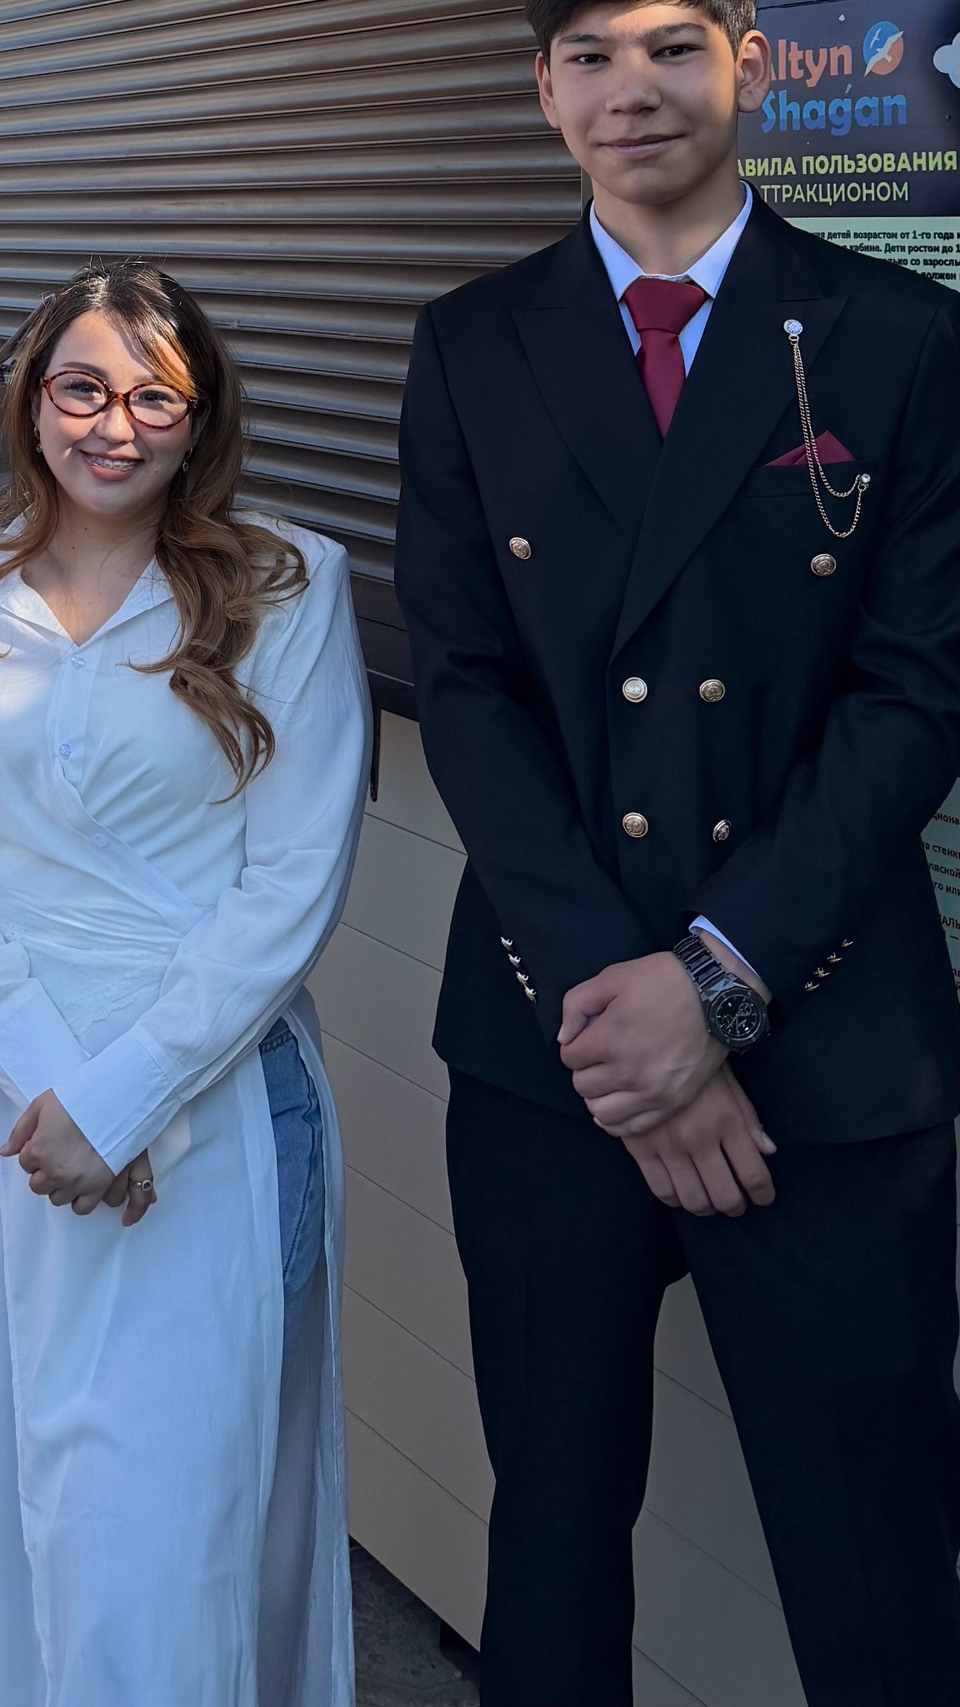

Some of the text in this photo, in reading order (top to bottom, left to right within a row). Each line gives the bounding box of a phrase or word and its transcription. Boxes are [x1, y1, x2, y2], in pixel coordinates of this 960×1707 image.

[802, 151, 958, 175] ПОЛЬЗОВАНИЯ
[760, 181, 909, 206] ТТРАКЦИОНОМ
[912, 230, 931, 239] 1-го
[933, 232, 955, 241] года
[884, 243, 906, 254] Дети
[908, 245, 940, 255] ростом
